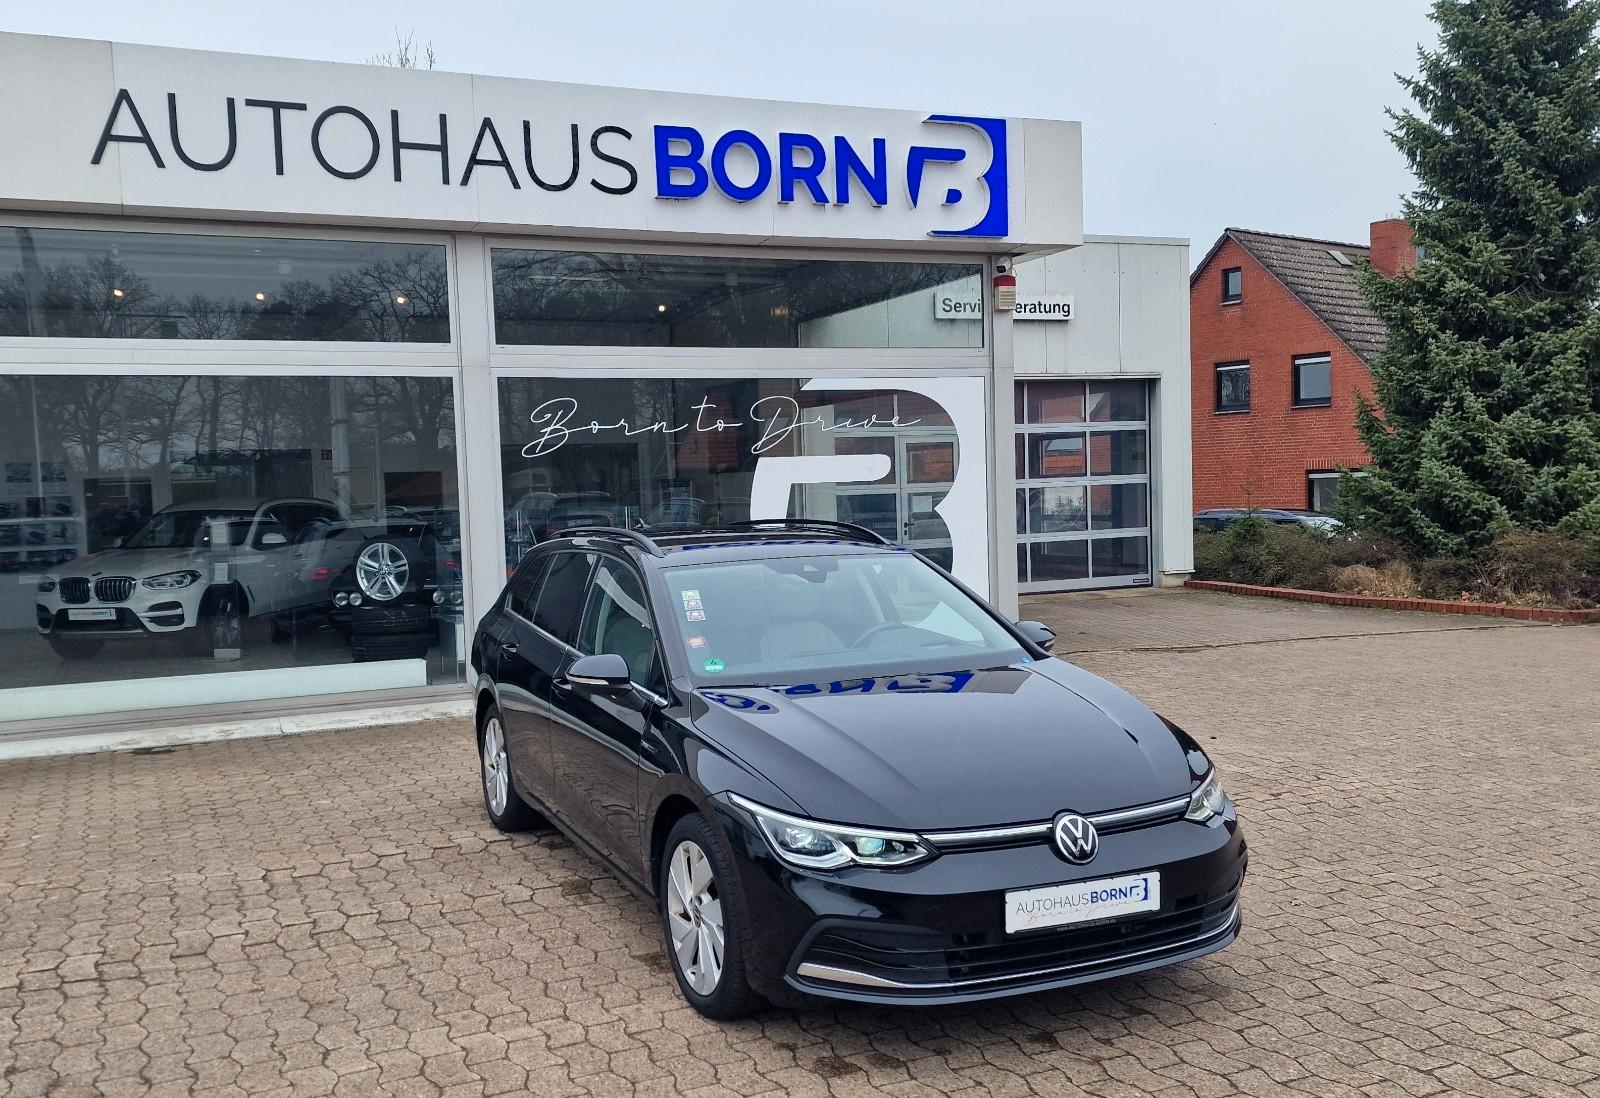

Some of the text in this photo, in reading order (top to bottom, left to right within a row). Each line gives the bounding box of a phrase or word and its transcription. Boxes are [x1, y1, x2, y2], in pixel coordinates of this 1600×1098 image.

[522, 395, 922, 457] Born to Drive
